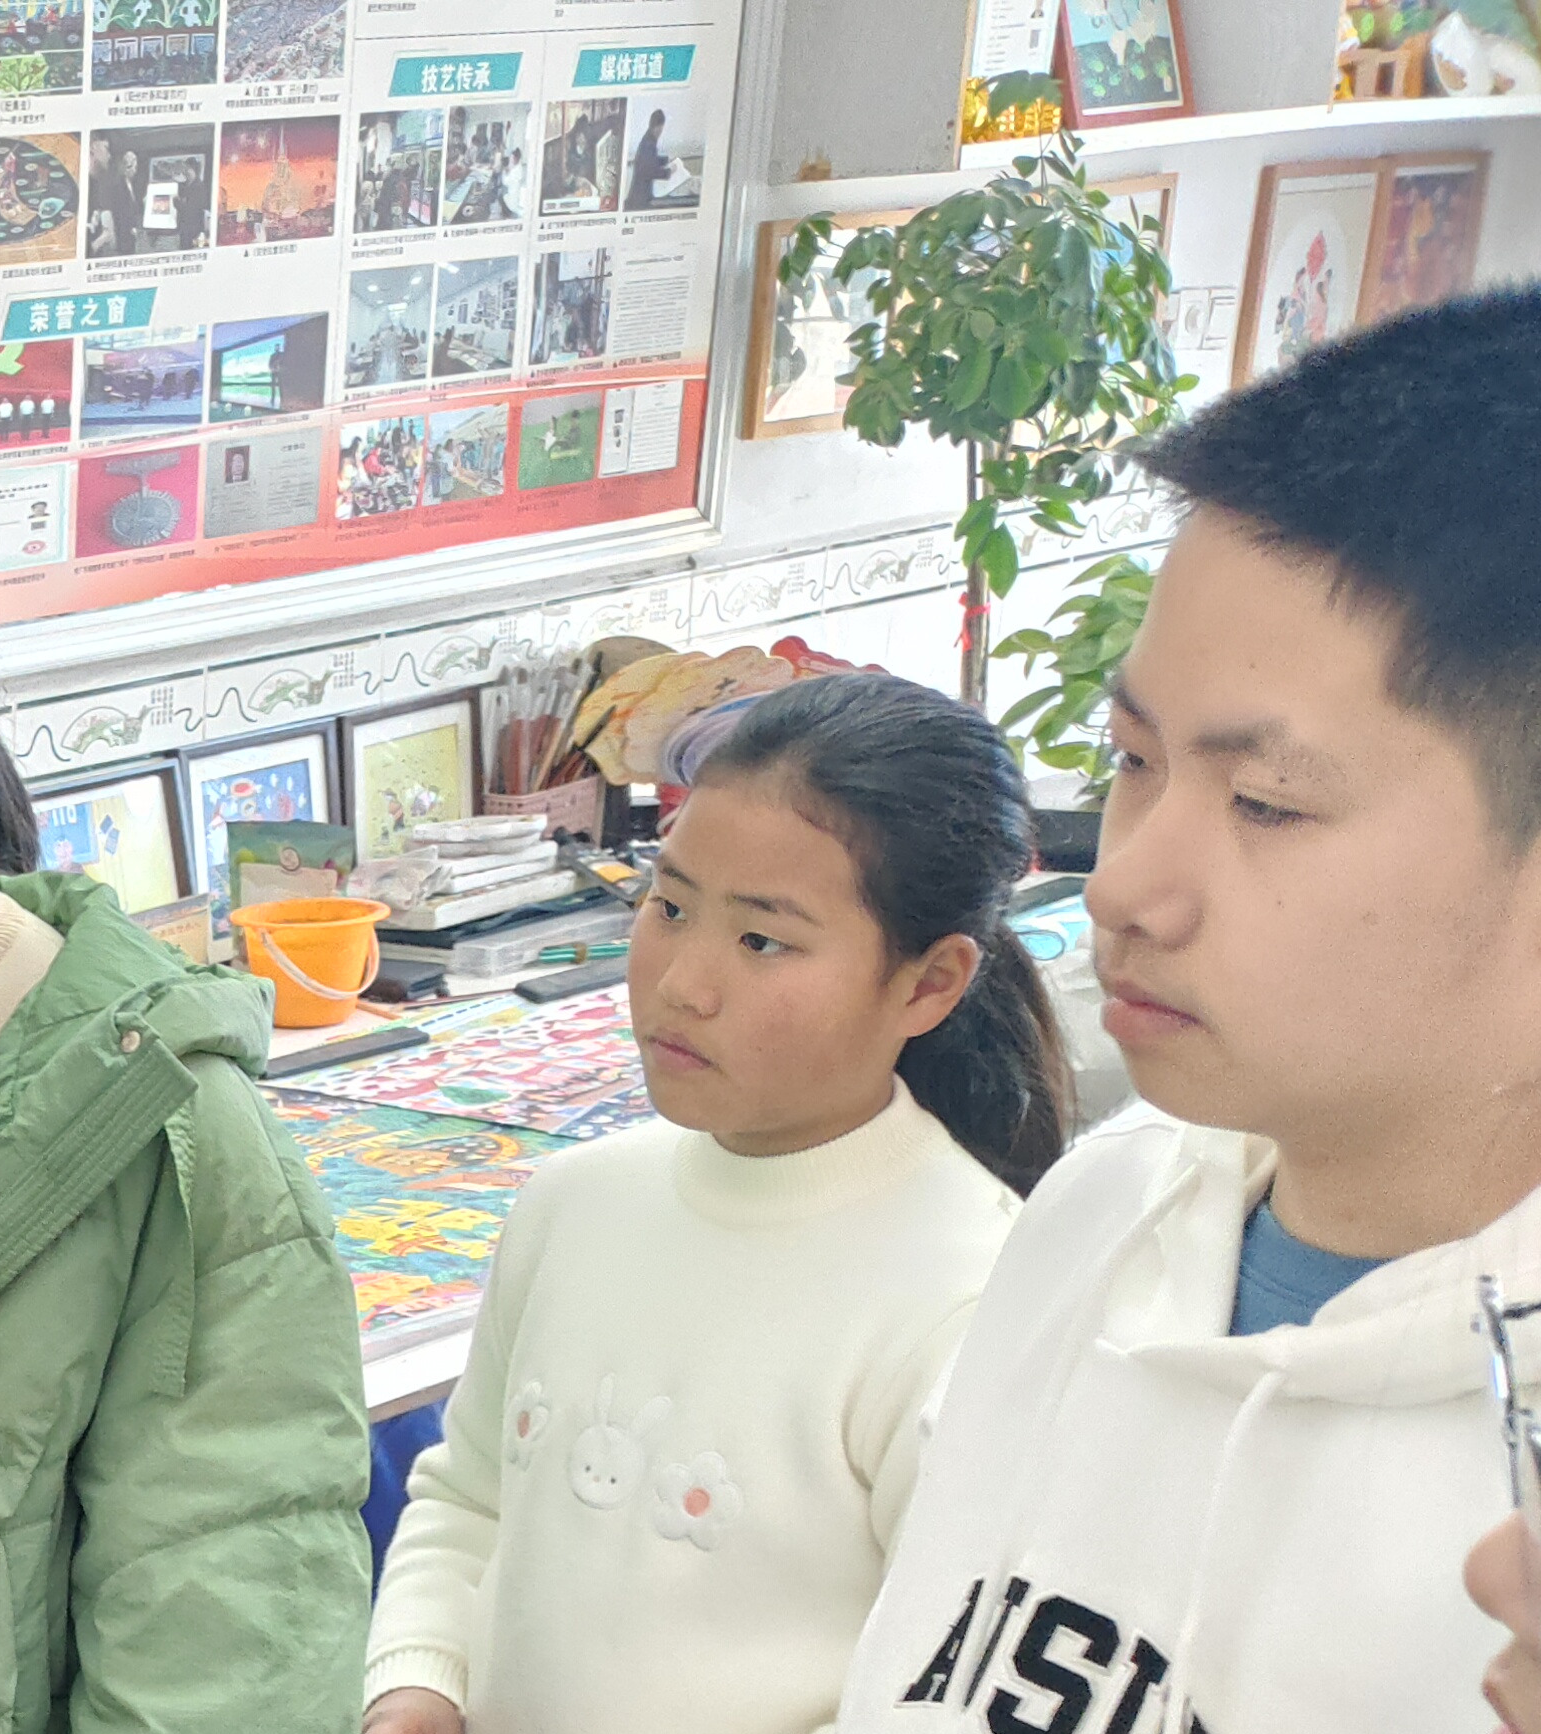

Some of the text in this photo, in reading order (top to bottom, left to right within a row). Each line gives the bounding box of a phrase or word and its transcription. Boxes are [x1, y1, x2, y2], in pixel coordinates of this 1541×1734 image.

[421, 61, 491, 93] 技艺传承
[599, 53, 664, 82] 媒体报道
[29, 294, 128, 334] 荣誉之窗
